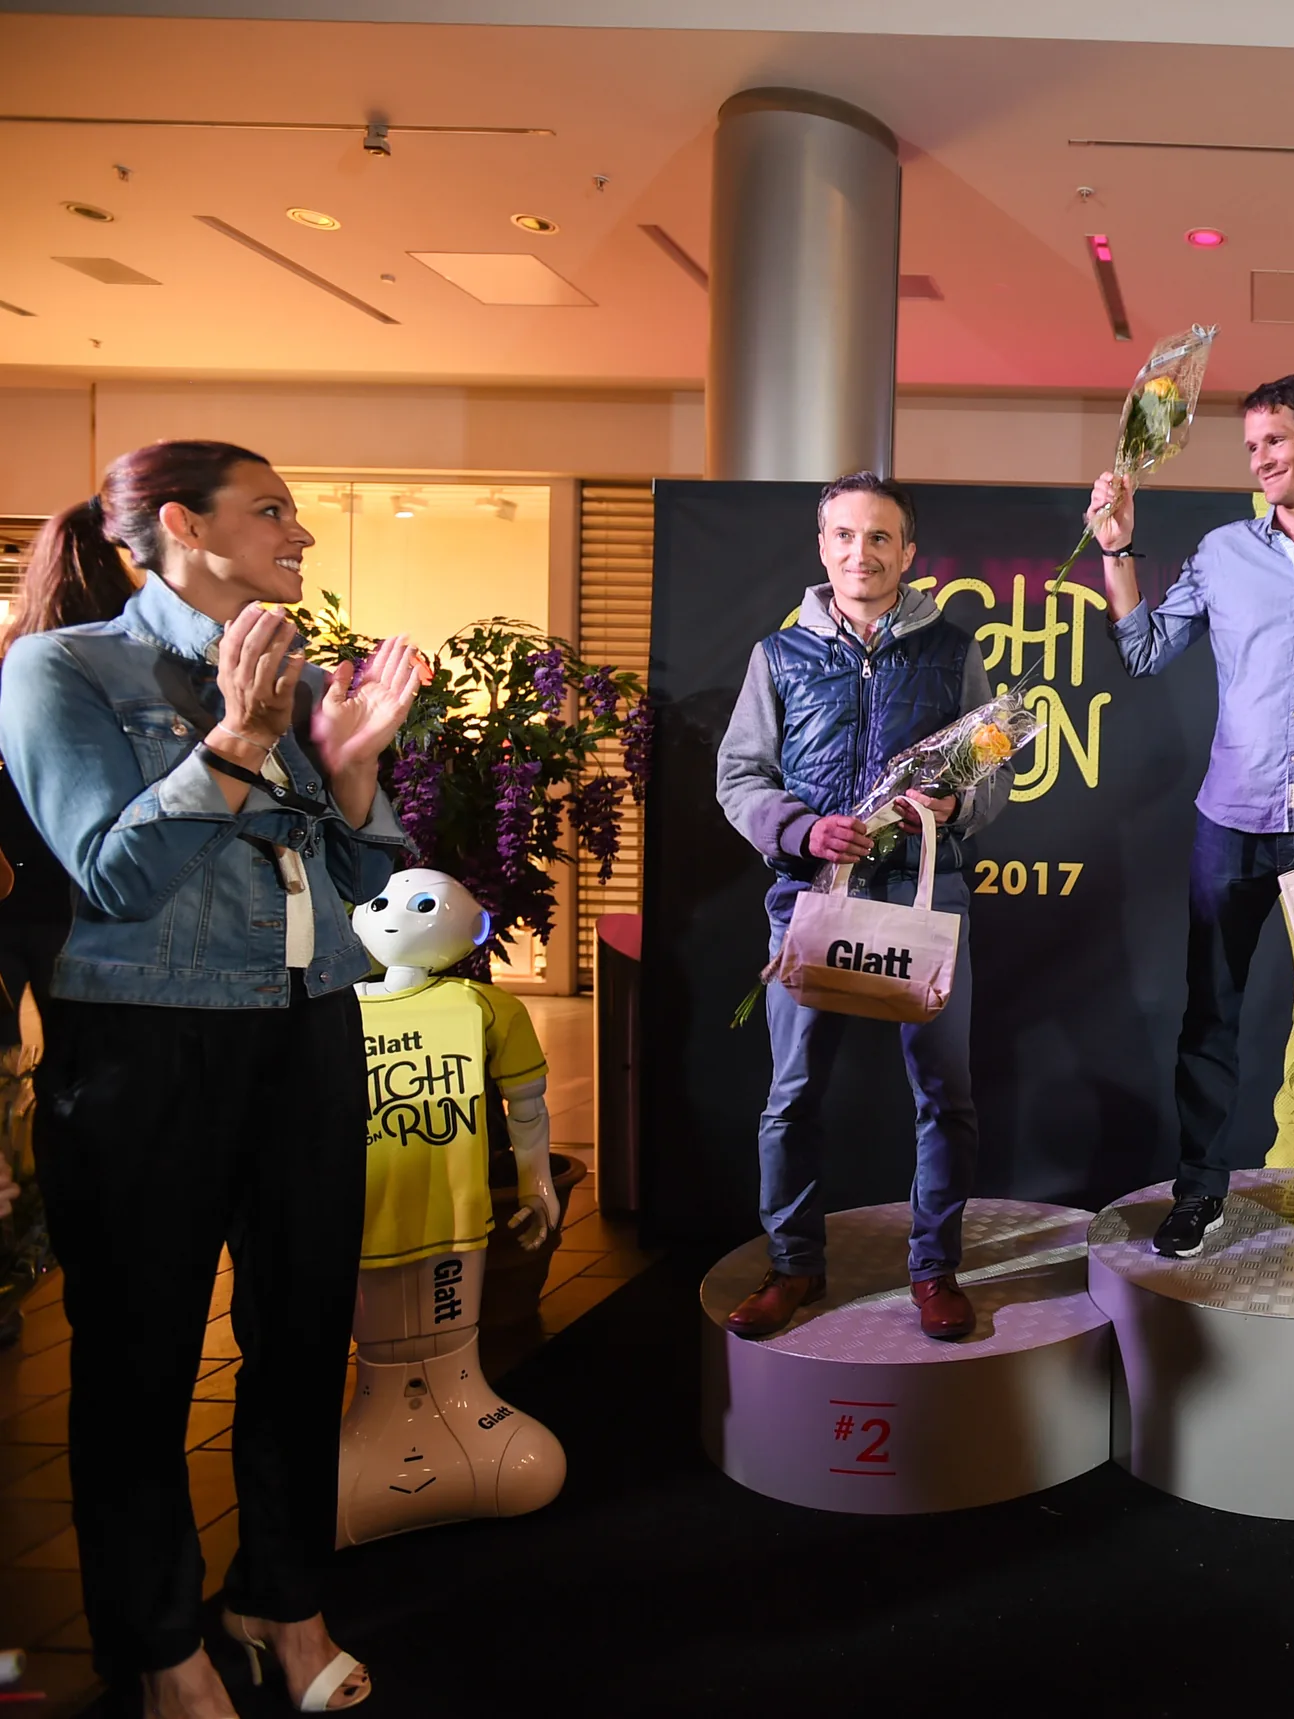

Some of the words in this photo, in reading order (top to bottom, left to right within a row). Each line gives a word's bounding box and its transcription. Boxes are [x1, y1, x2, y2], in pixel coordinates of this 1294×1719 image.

[973, 859, 1084, 896] 2017
[826, 939, 912, 980] Glatt
[364, 1031, 423, 1056] Glatt
[366, 1054, 472, 1120] IGHT
[381, 1095, 480, 1146] RUN
[434, 1259, 462, 1324] Glatt
[478, 1406, 514, 1430] Glatt
[833, 1414, 892, 1463] #2
